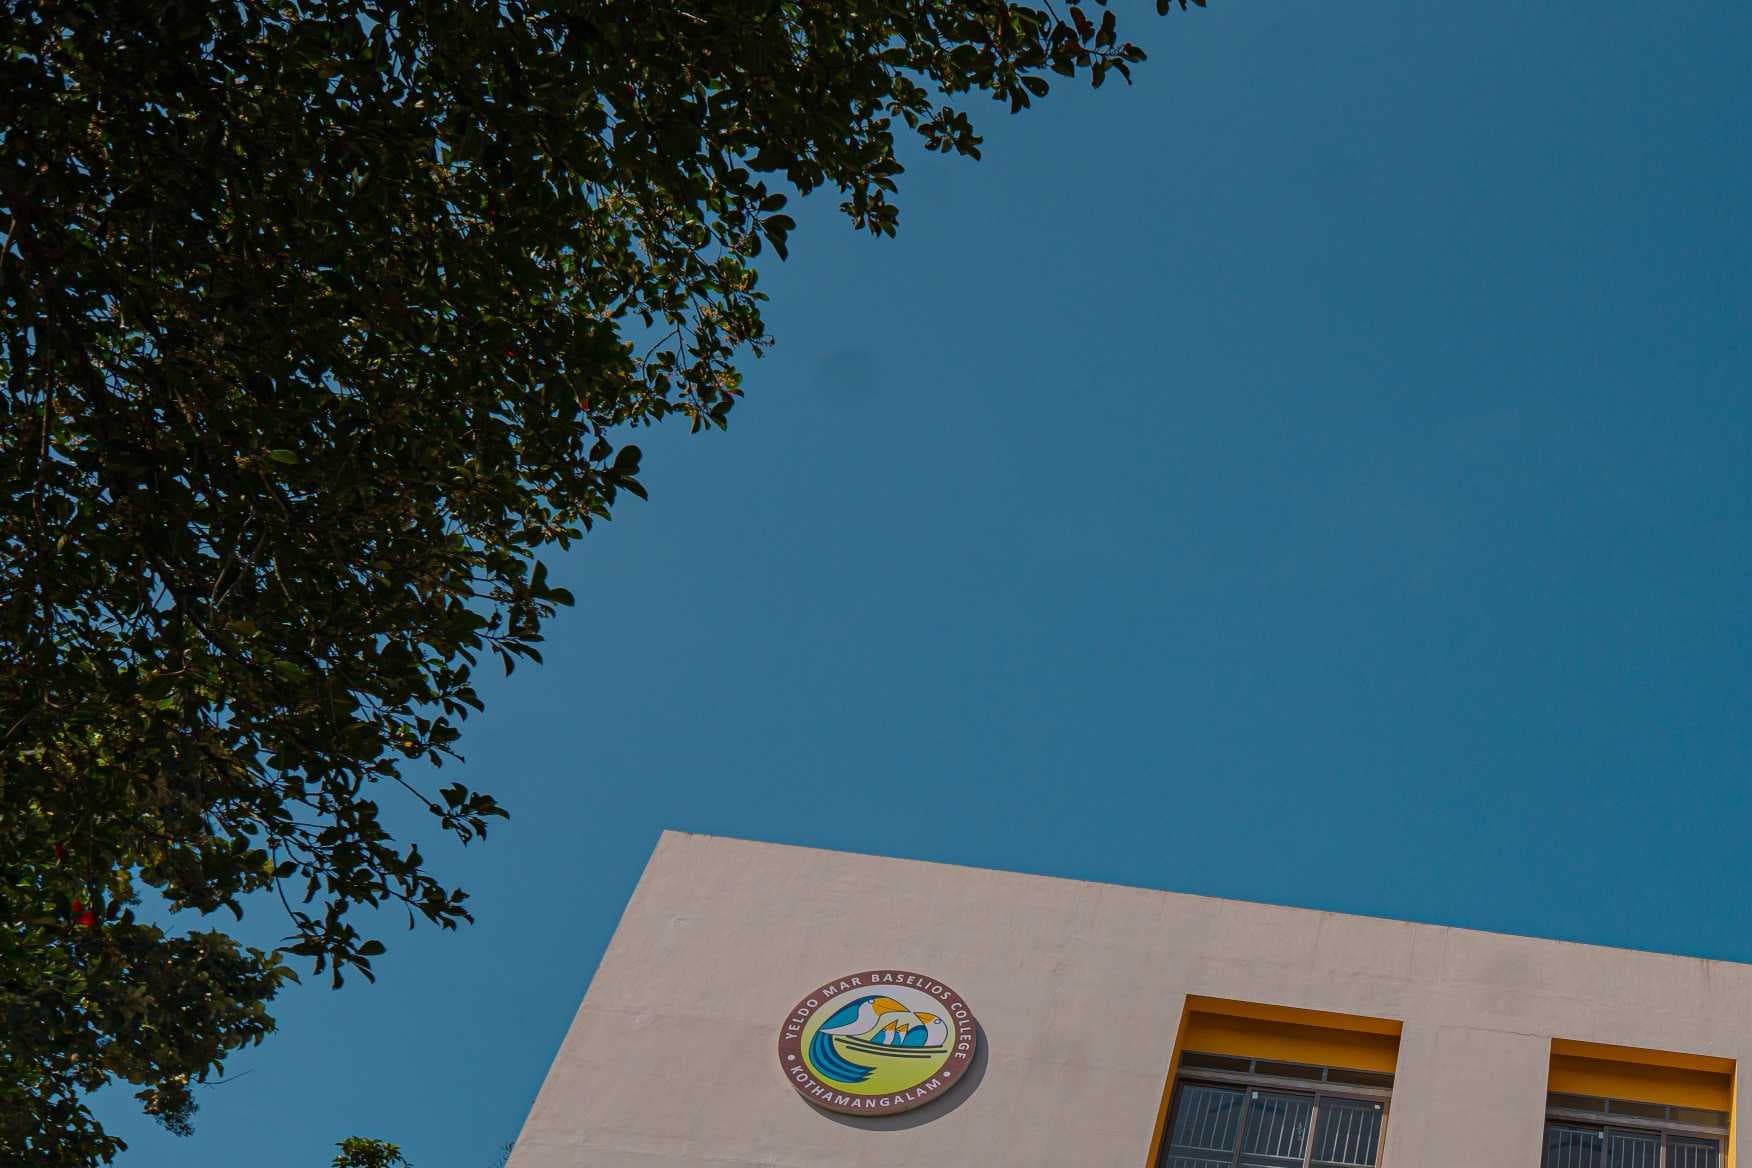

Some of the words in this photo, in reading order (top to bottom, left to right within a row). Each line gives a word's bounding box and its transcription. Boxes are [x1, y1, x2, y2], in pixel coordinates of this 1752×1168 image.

[785, 999, 818, 1040] YELDO
[823, 976, 862, 998] MAR
[871, 973, 951, 1000] BASELIOS
[950, 1001, 972, 1060] COLLEGE
[790, 1065, 941, 1107] KOTHAMANGALAM
